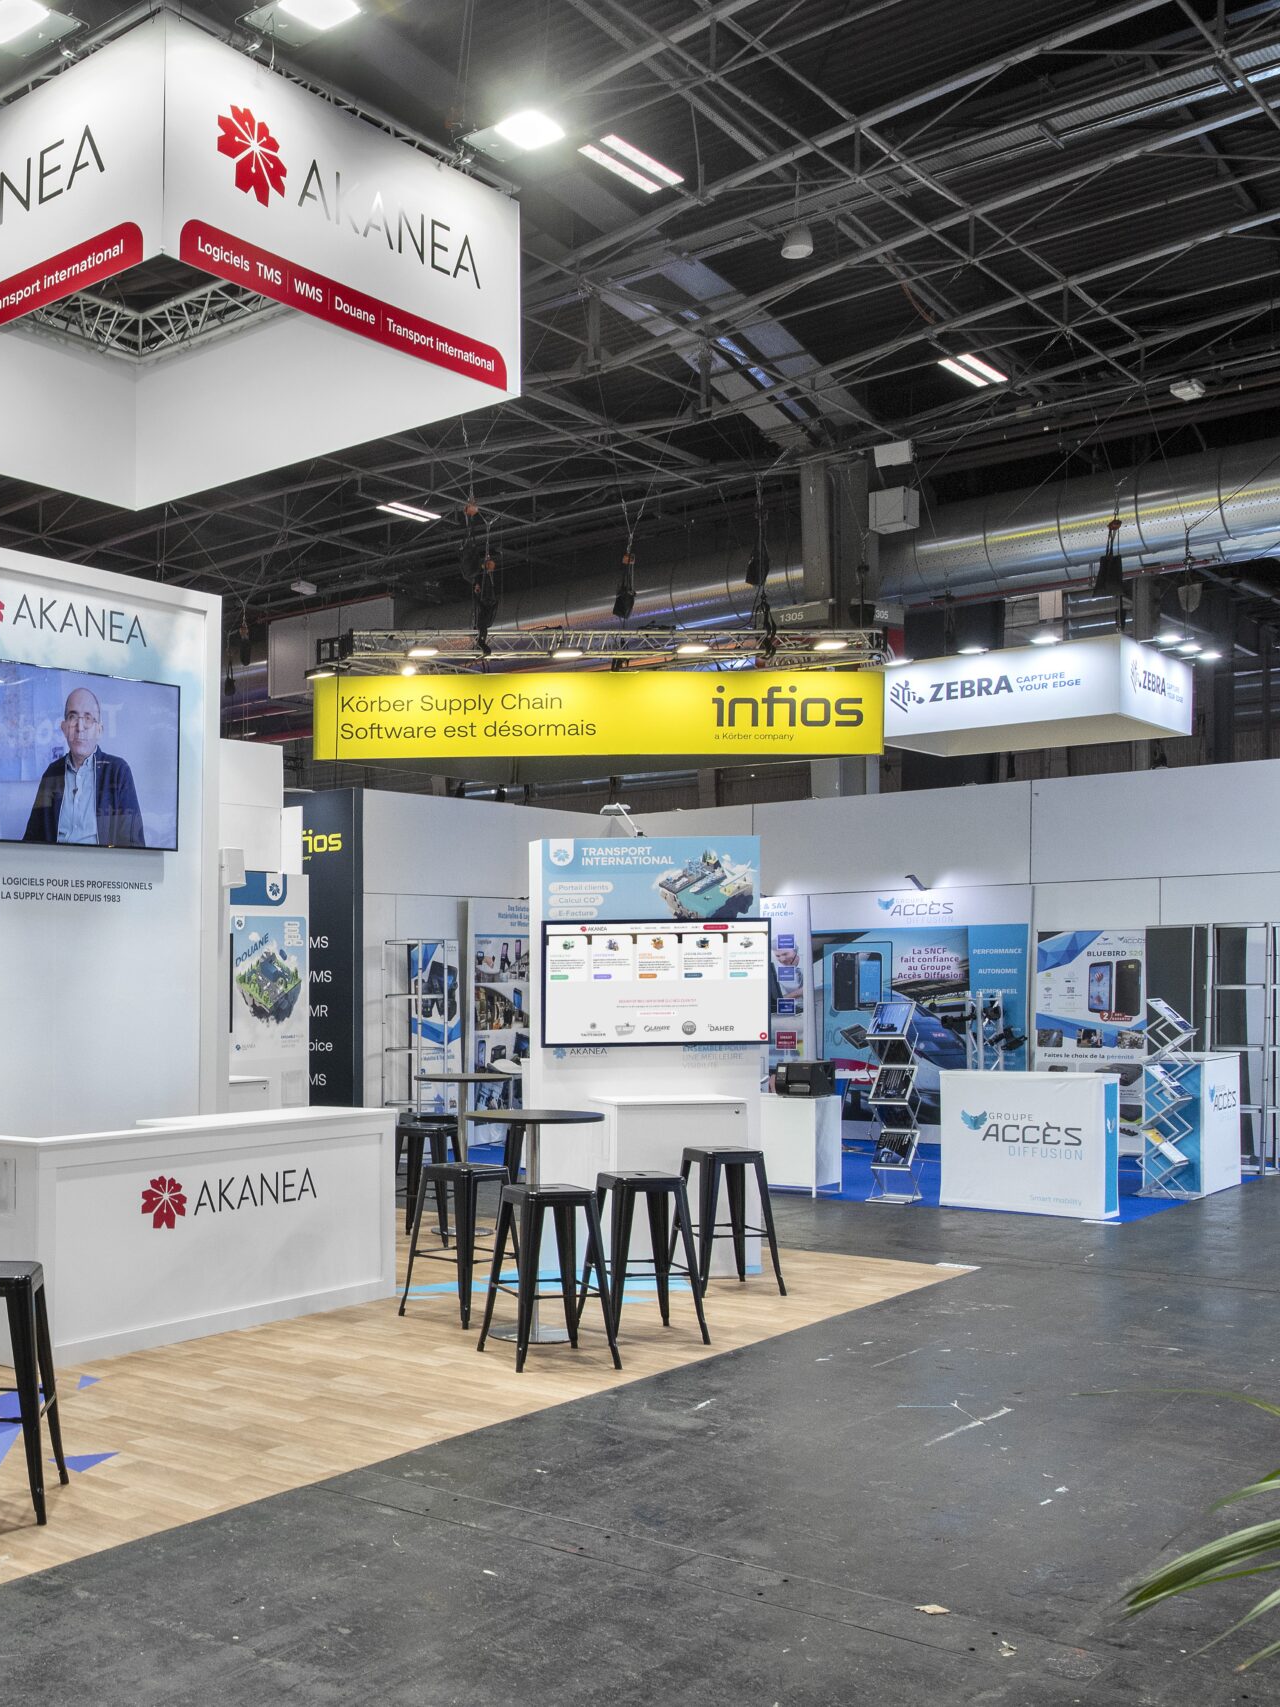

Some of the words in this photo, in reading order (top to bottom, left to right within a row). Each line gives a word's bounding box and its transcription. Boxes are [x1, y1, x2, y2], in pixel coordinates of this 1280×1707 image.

[297, 159, 481, 290] AKANEA
[43, 239, 124, 289] international
[198, 236, 250, 272] Logiciels
[256, 262, 282, 285] TMS
[293, 278, 323, 303] WMS
[334, 295, 376, 325] Douane
[387, 317, 434, 348] Transport
[435, 337, 495, 373] international
[12, 594, 147, 647] AKANEA
[1016, 671, 1065, 684] CAPTURE
[1142, 670, 1167, 697] ZEBRA
[928, 675, 1014, 703] ZEBRA
[1019, 682, 1048, 692] YOUR
[1052, 678, 1081, 689] EDGE
[340, 695, 413, 713] Körber
[420, 693, 494, 715] Supply
[500, 692, 563, 710] Chain
[711, 685, 864, 727] infios
[340, 722, 437, 740] Software
[443, 721, 477, 738] est
[483, 719, 597, 738] désormais
[722, 732, 752, 740] Körber
[754, 734, 794, 742] company
[581, 846, 653, 857] TRANSPORT
[581, 855, 675, 866] INTERNATIONAL
[2, 877, 45, 887] LOGICIELS
[46, 879, 69, 888] POUR
[70, 880, 85, 889] LES
[86, 880, 153, 891] PROFESSIONNELS
[558, 884, 583, 892] Portail
[584, 884, 609, 892] clients
[0, 891, 12, 900] LA
[13, 891, 45, 901] SUPPLY
[46, 892, 71, 902] CHAIN
[73, 893, 102, 903] DEPUIS
[103, 894, 121, 903] 1983
[558, 909, 594, 917] E-Facture
[890, 901, 954, 917] ACCÈS
[906, 915, 954, 924] DIFFUSION
[235, 932, 269, 968] DOUANE
[924, 947, 947, 955] SNCF
[973, 947, 1023, 955] PERFORMANCE
[917, 955, 960, 963] confiance
[920, 964, 952, 972] Groupe
[978, 967, 1018, 975] AUTONOMIE
[897, 971, 921, 979] Accès
[925, 971, 964, 979] Diffusion
[1103, 1012, 1109, 1020] 2
[570, 1047, 608, 1056] AKANEA
[988, 1112, 1033, 1122] GROUPE
[982, 1121, 1082, 1146] ACCÈS
[1008, 1145, 1083, 1161] DIFFUSION
[194, 1167, 317, 1216] AKANEA
[1030, 1194, 1052, 1203] Smart
[1053, 1196, 1082, 1207] mobility
